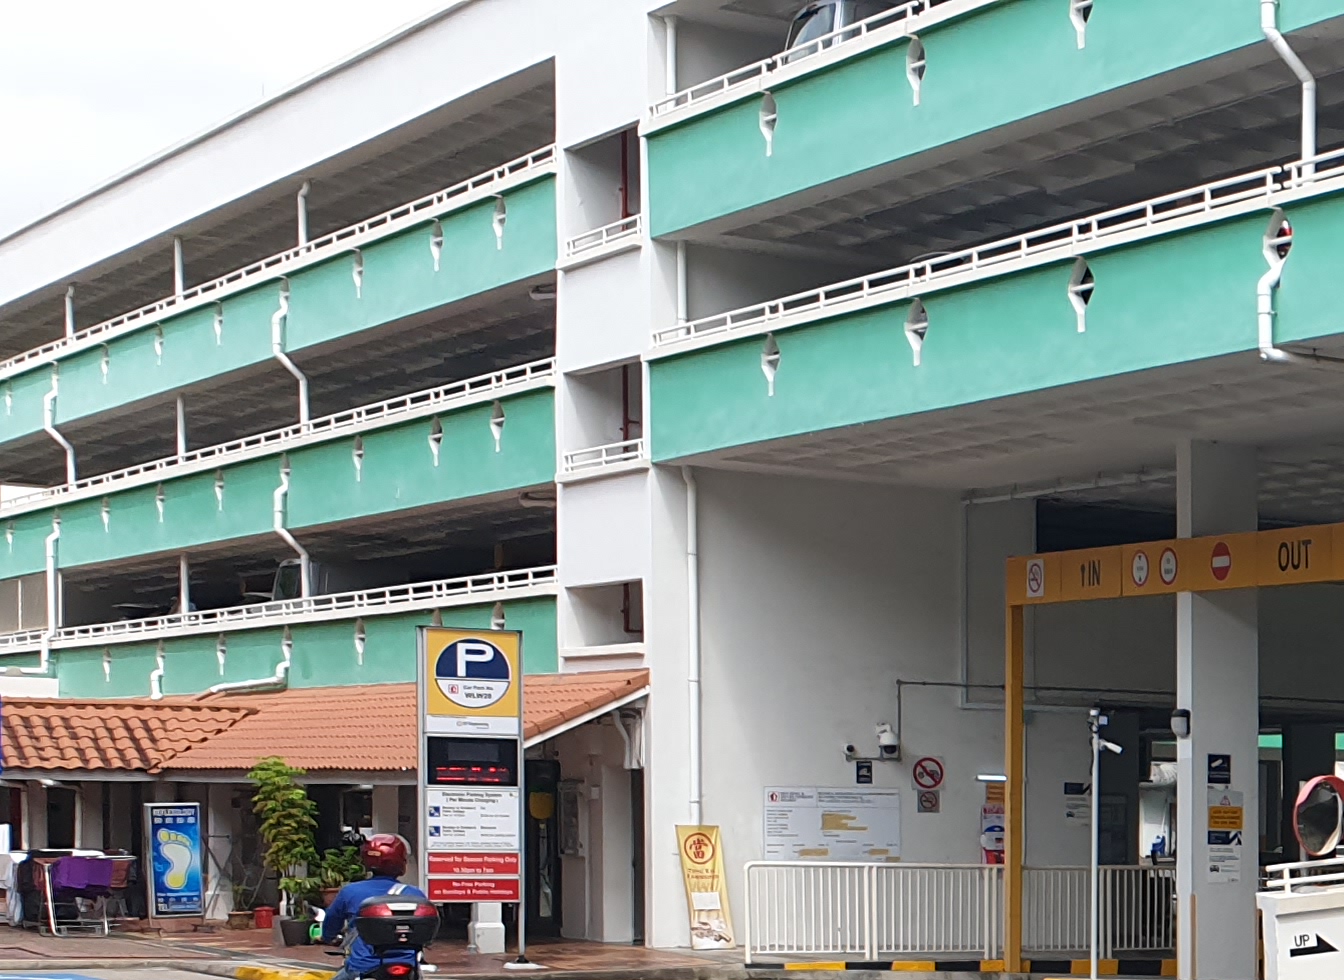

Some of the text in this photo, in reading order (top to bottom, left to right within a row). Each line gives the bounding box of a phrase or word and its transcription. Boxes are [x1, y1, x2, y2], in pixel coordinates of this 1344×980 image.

[1278, 539, 1312, 571] OUT
[1088, 560, 1101, 587] IN
[457, 643, 494, 677] P
[1294, 934, 1310, 947] UP
